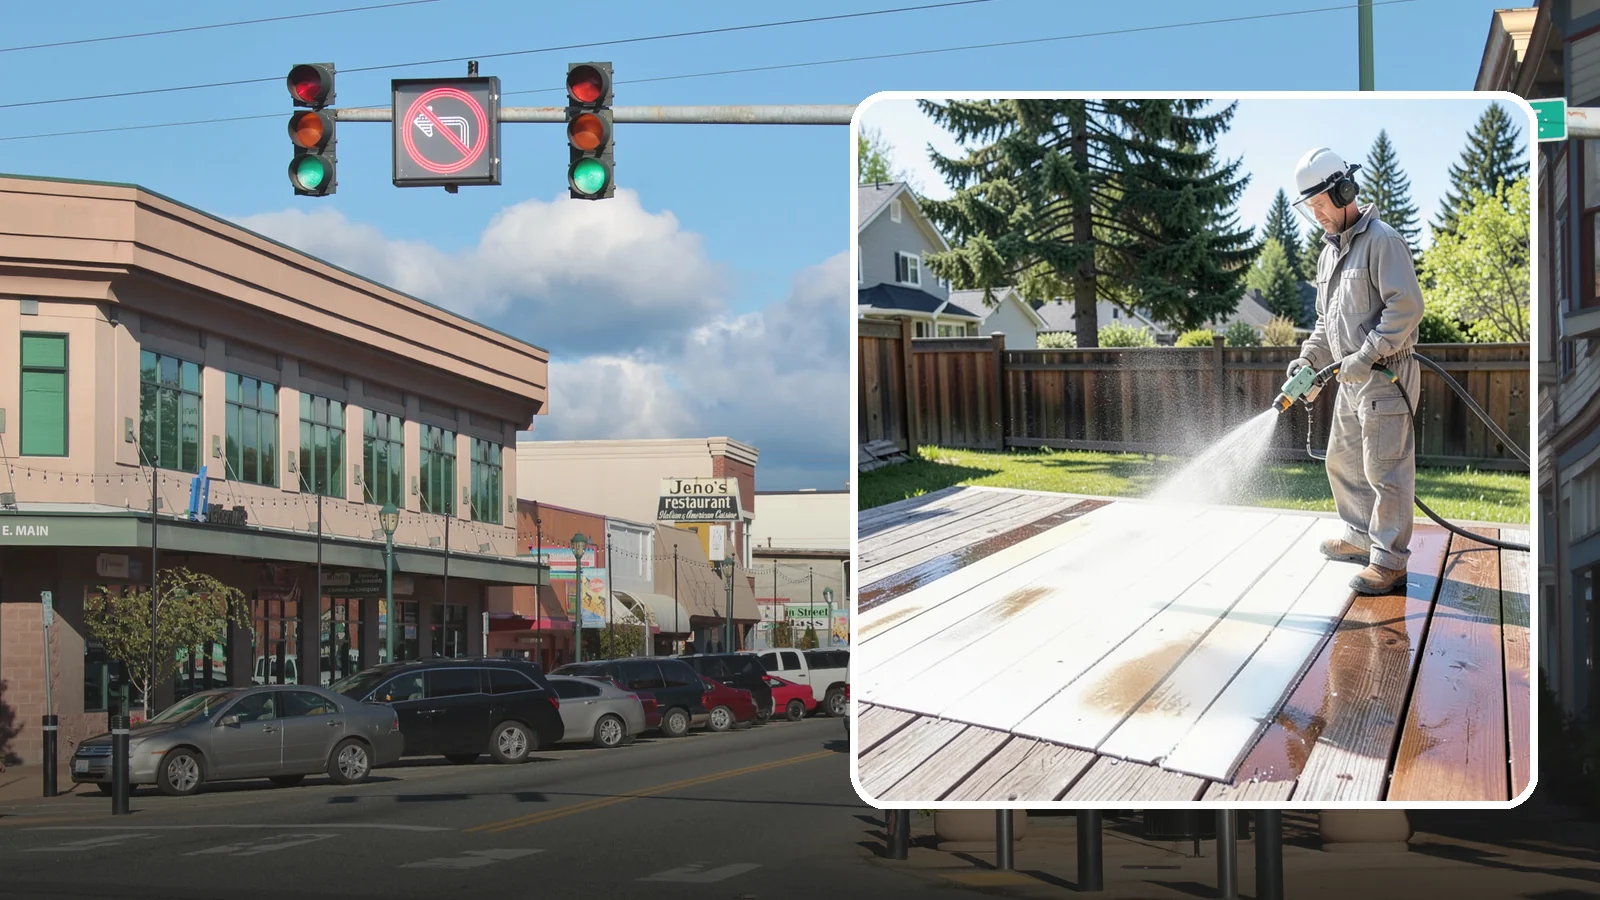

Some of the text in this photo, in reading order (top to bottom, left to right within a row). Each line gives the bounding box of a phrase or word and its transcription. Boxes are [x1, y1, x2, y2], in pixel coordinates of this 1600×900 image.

[670, 480, 727, 494] Jeno's
[665, 496, 731, 509] restaurant
[659, 510, 681, 519] Italian
[686, 510, 714, 519] American
[715, 510, 737, 519] Cuisine
[2, 525, 49, 536] E. MAIN
[785, 607, 828, 617] in Street
